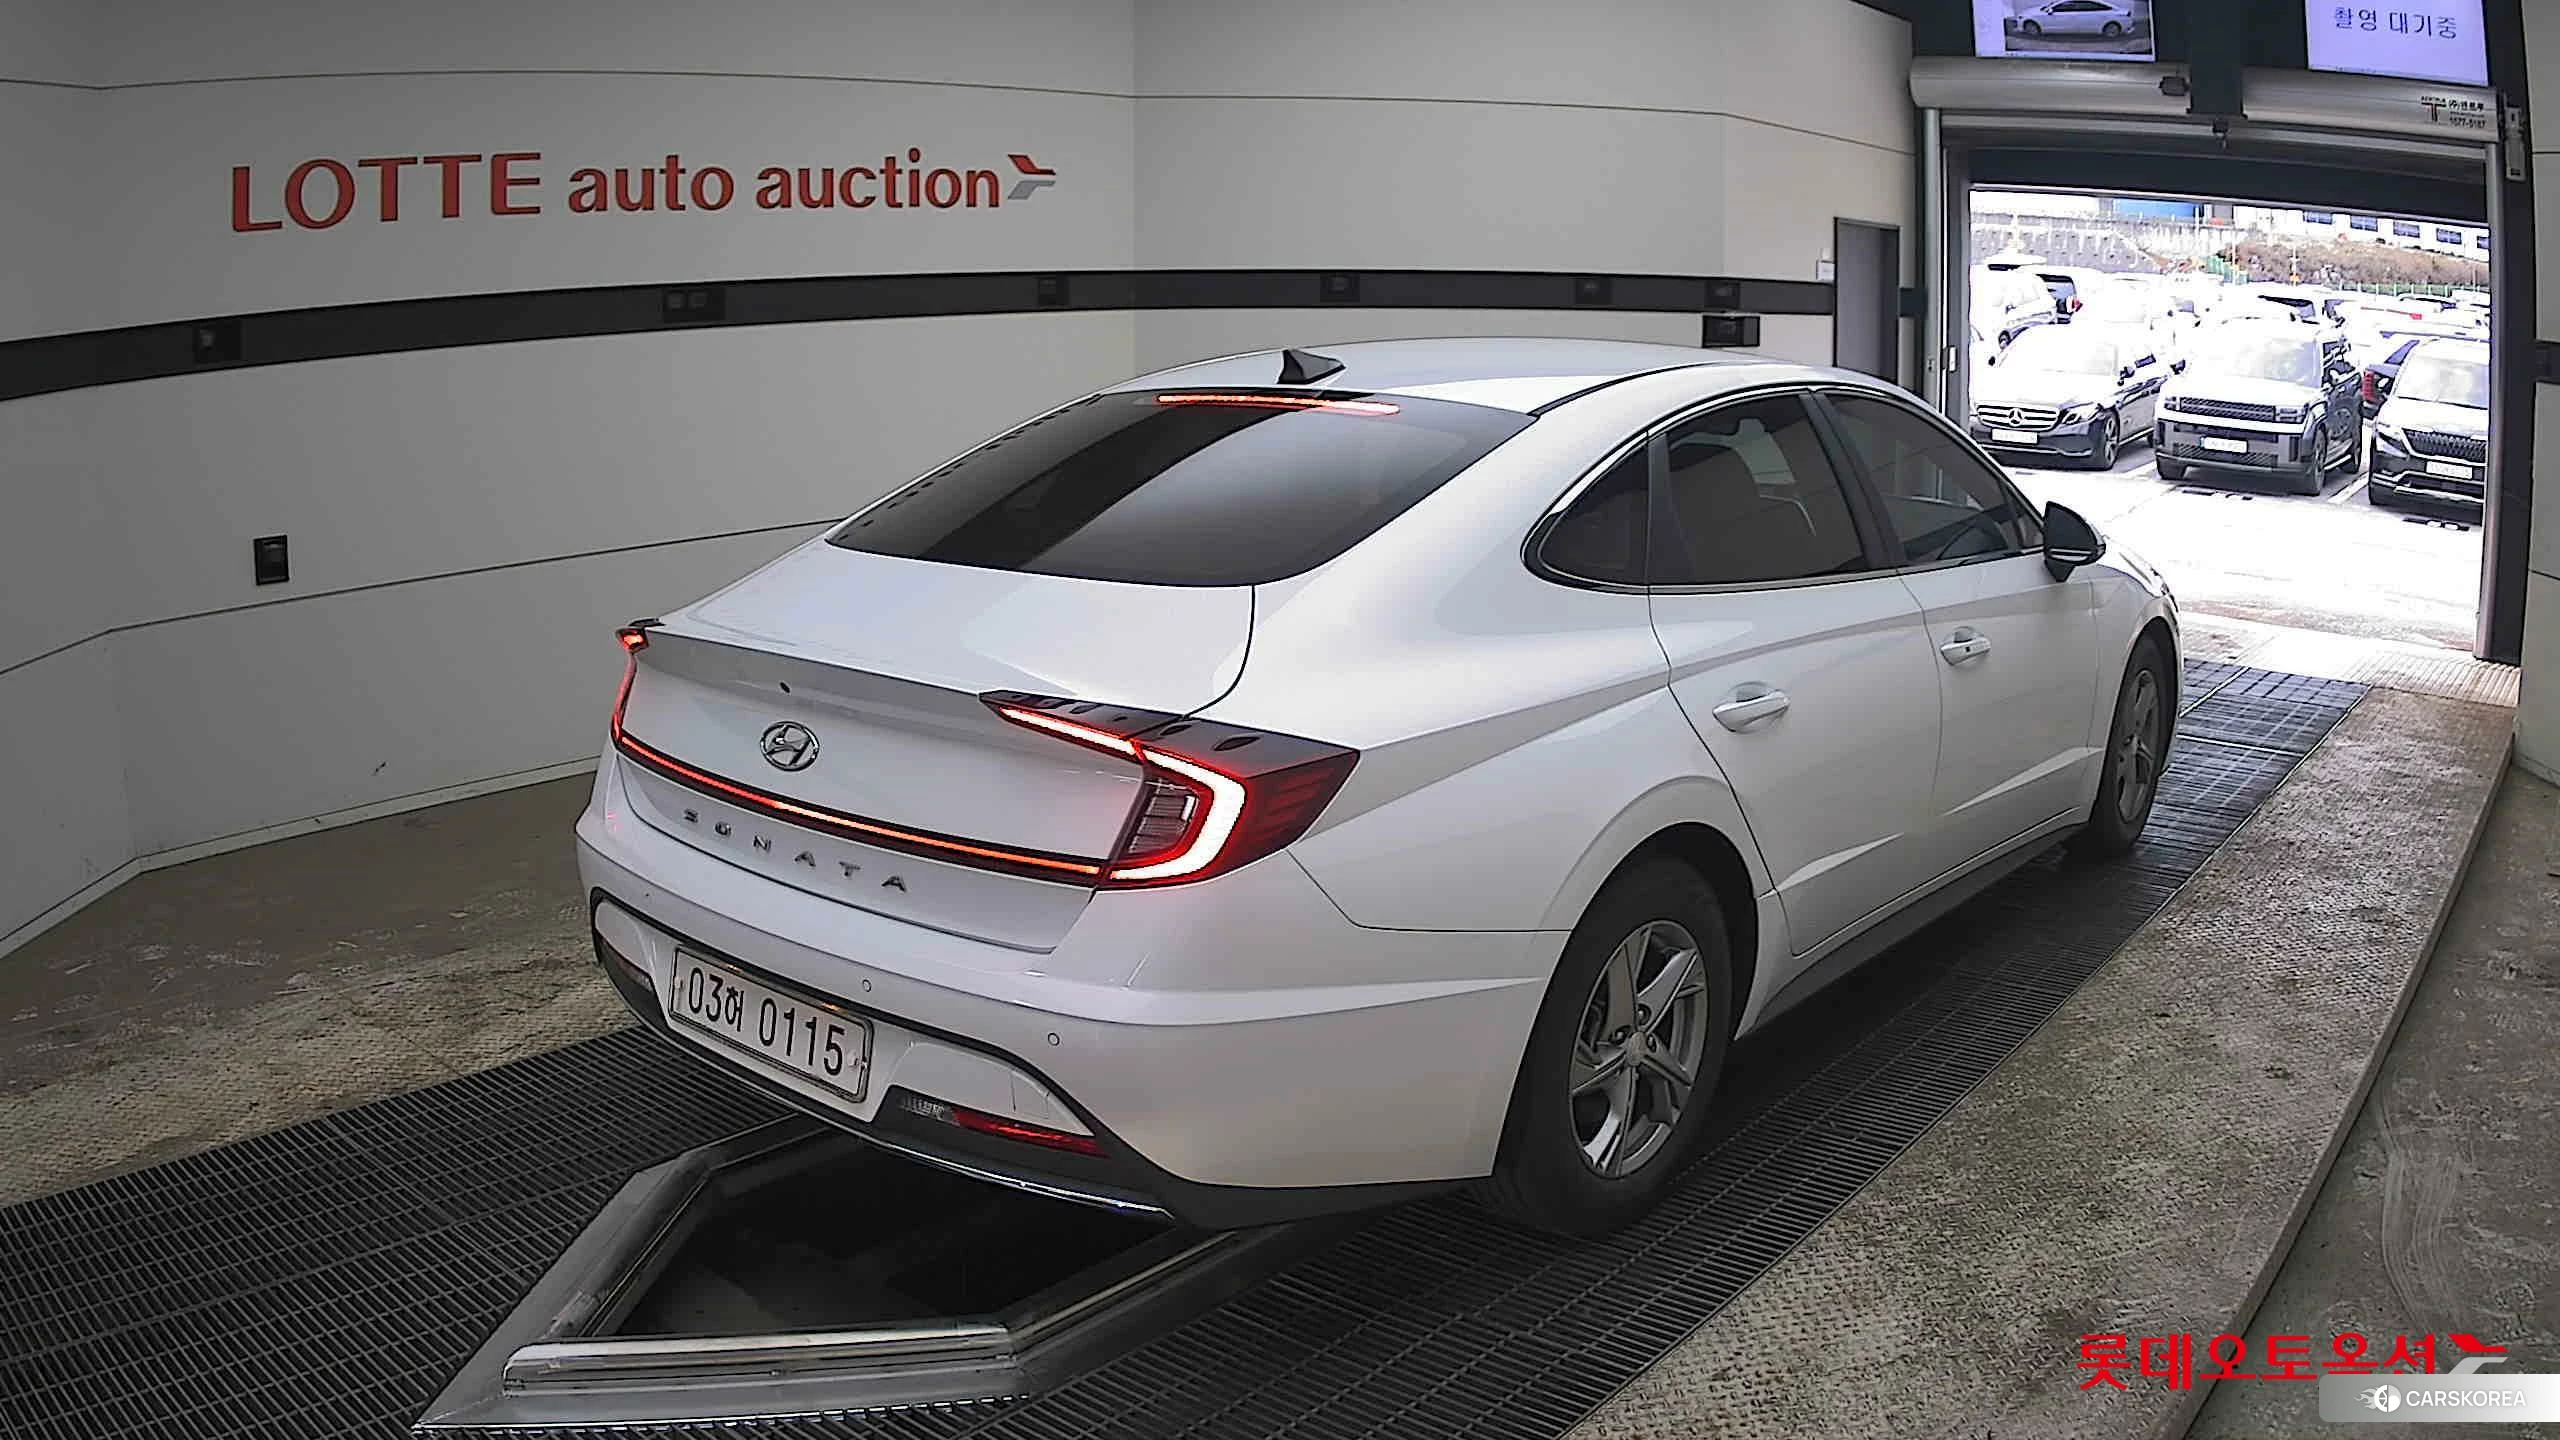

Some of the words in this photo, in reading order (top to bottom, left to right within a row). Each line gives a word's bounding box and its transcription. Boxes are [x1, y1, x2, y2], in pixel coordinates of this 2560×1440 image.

[2335, 7, 2377, 31] 촬영
[2389, 12, 2457, 39] 대기중
[231, 152, 542, 233] LOTTE
[567, 154, 735, 212] auto
[755, 147, 1001, 209] auction
[683, 808, 907, 892] SONATA
[688, 967, 745, 1032] 03허
[759, 998, 846, 1076] 0115
